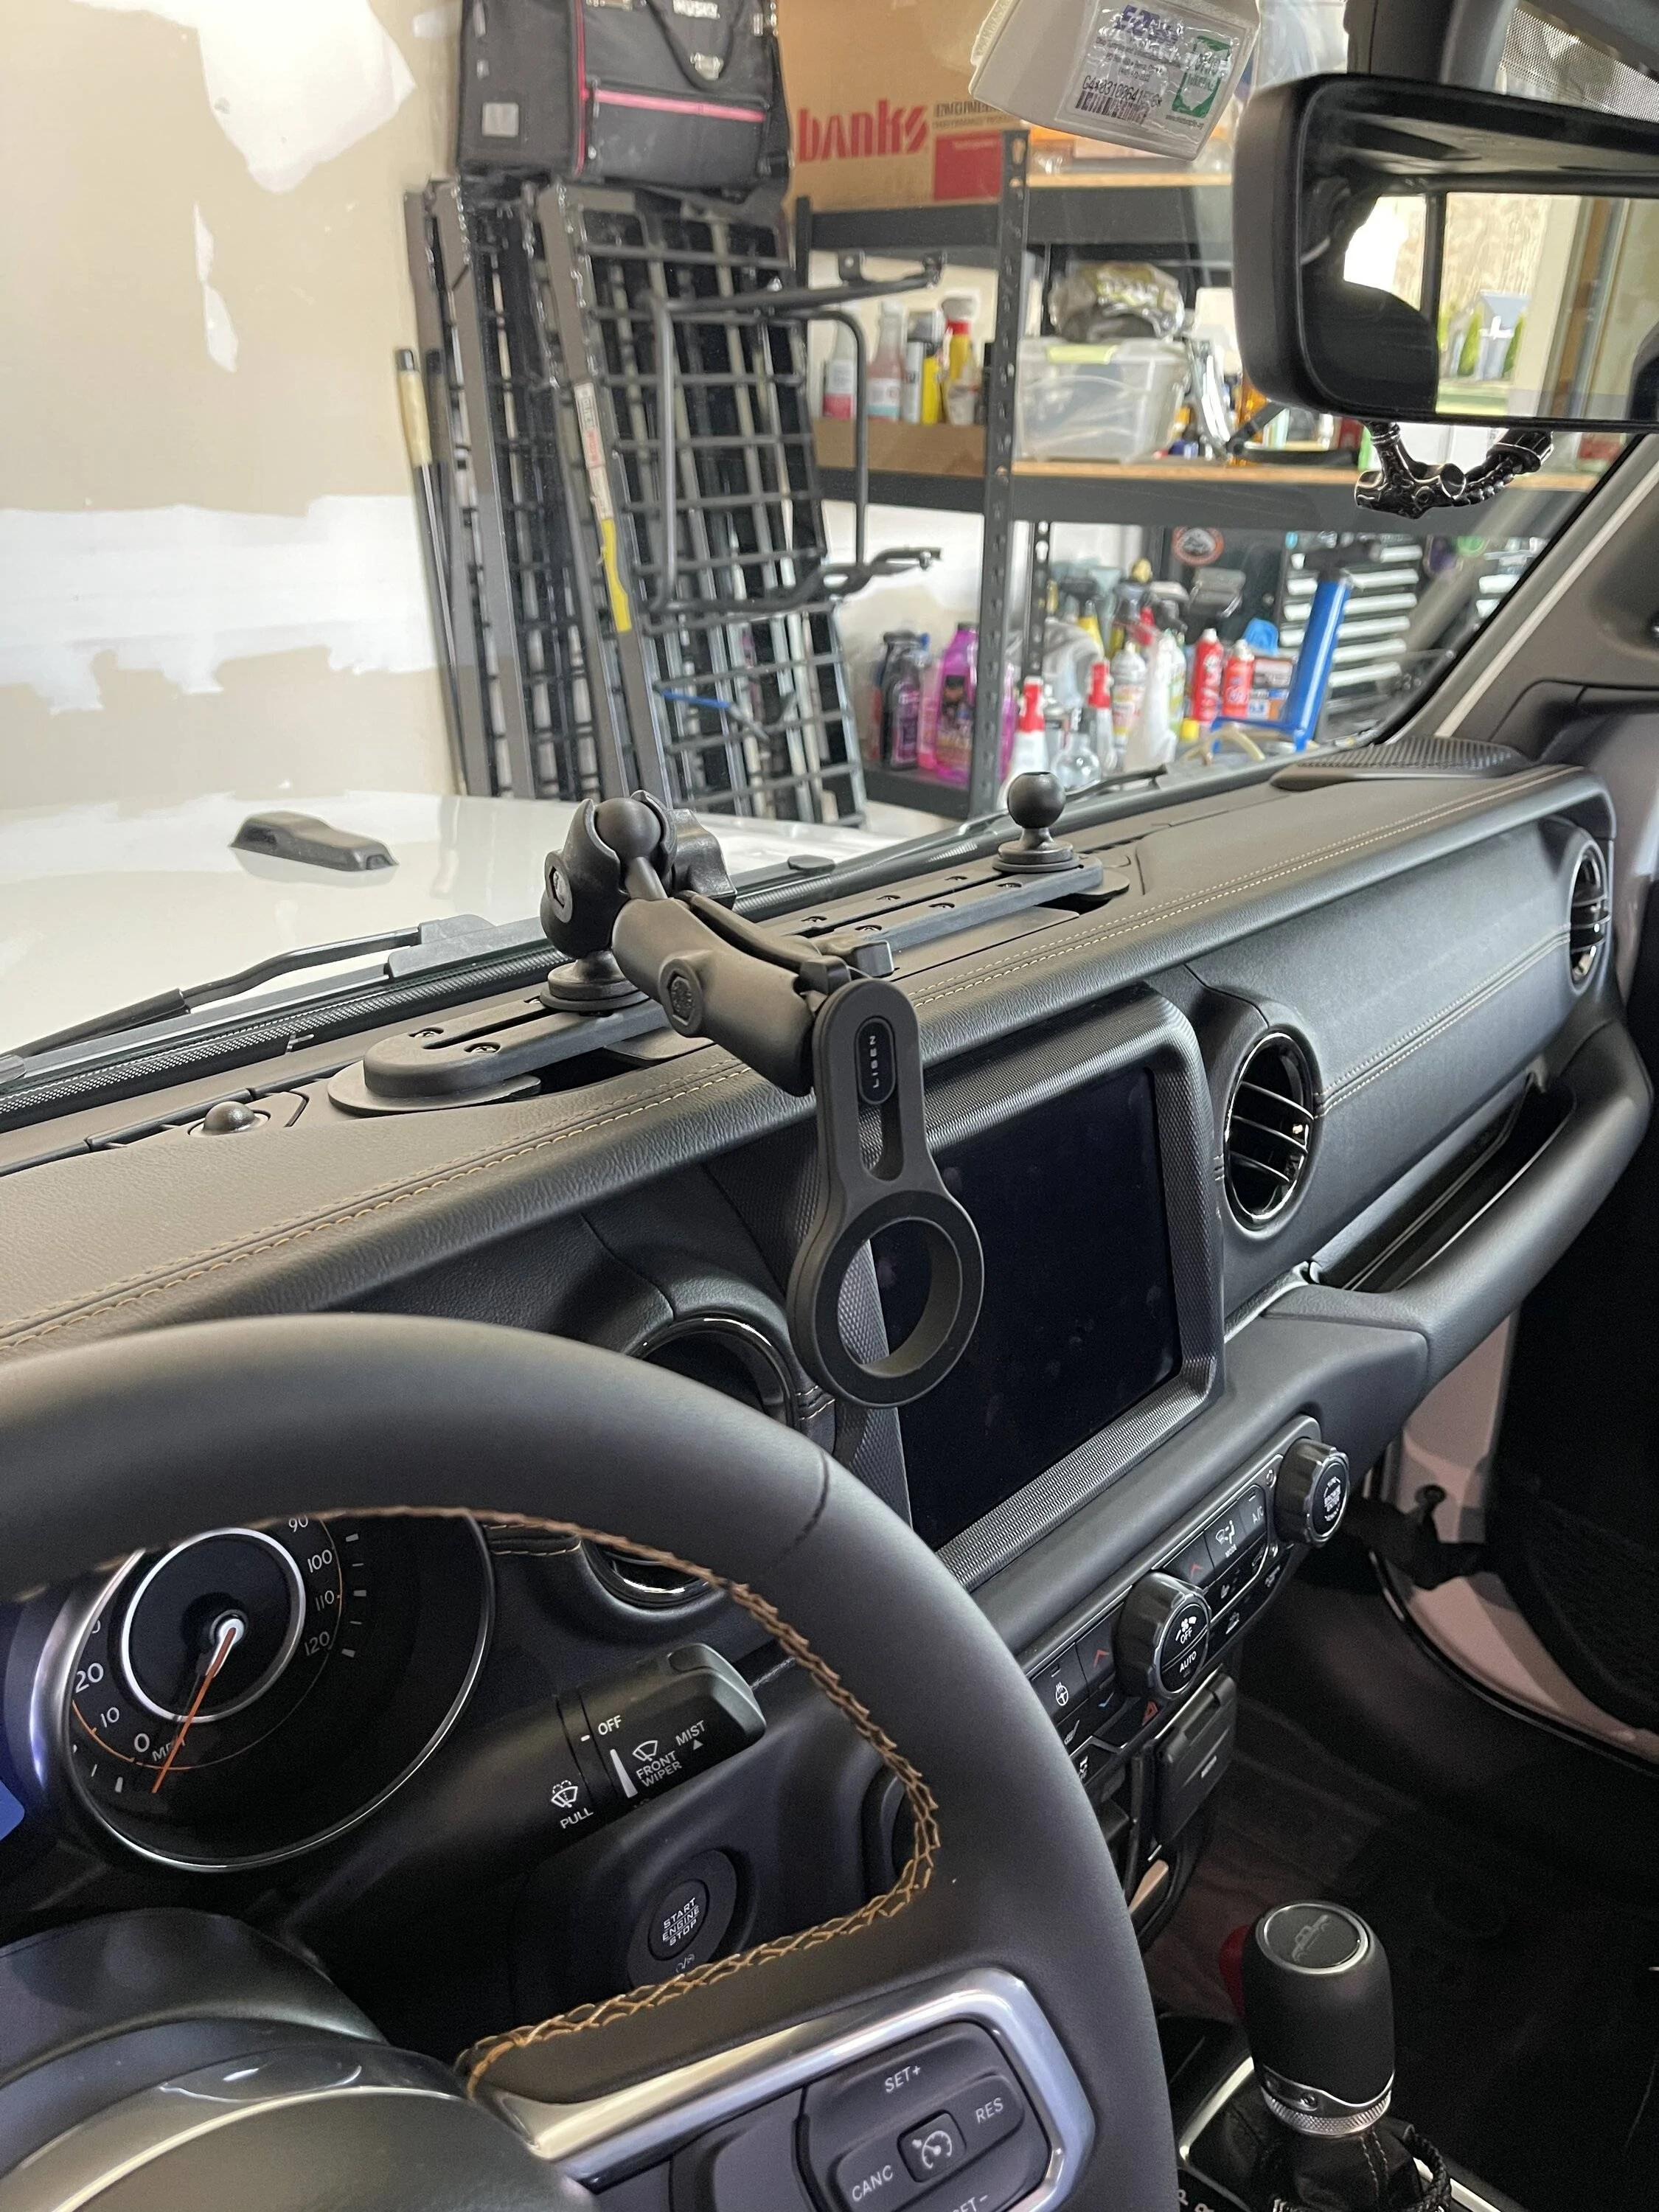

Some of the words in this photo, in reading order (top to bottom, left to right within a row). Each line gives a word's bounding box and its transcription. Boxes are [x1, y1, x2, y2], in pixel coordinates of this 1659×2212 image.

[307, 1549, 333, 1573] 100
[315, 1590, 335, 1612] 110
[304, 1631, 330, 1656] 120
[1180, 1626, 1193, 1644] OFF
[1179, 1650, 1197, 1673] AUTO
[74, 1662, 105, 1694] 20
[100, 1706, 120, 1728] 10
[597, 1714, 622, 1736] OFF
[675, 1719, 706, 1747] MIST
[635, 1750, 677, 1781] FRONT
[641, 1760, 684, 1788] WIPER
[560, 1807, 594, 1829] PULL
[662, 1905, 700, 1942] ENGINE
[664, 1897, 696, 1930] START
[669, 1918, 698, 1947] STOP
[883, 2065, 922, 2094] SET+
[974, 2096, 1005, 2125] RES
[851, 2164, 894, 2203] CANC
